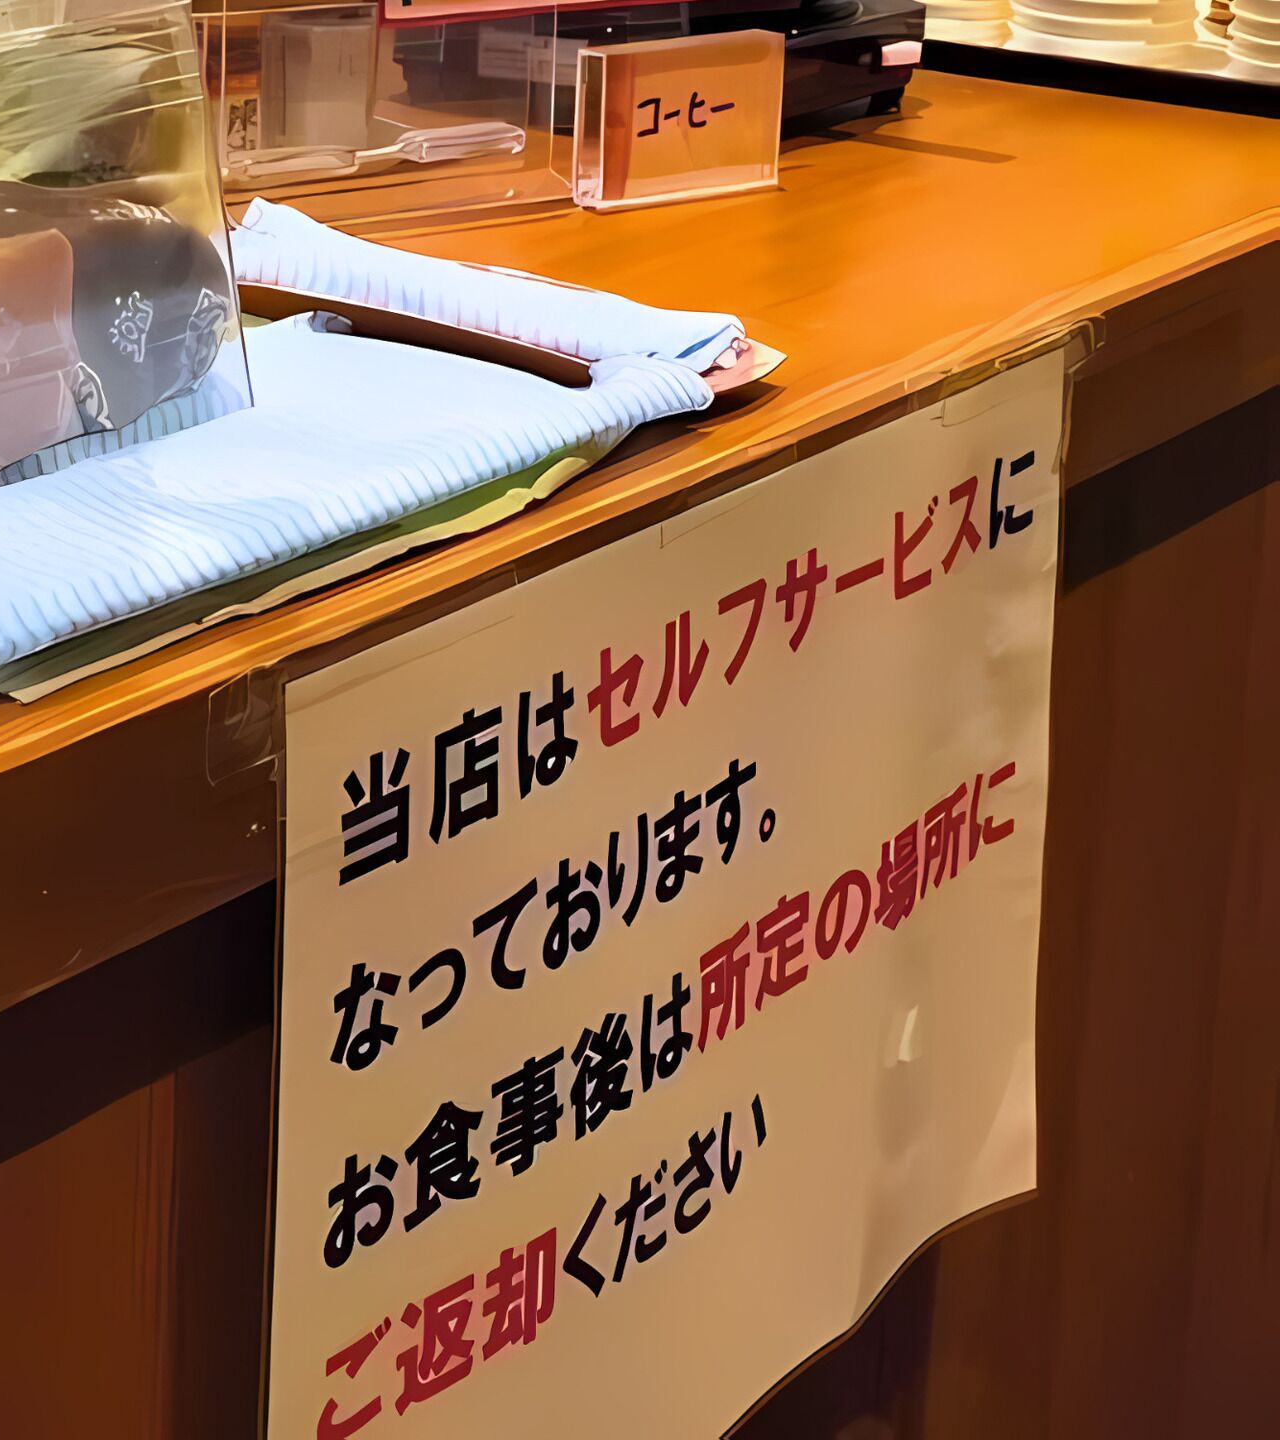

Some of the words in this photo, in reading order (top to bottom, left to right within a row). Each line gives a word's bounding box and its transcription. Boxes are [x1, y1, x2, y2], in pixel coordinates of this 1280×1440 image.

[637, 92, 735, 137] コーヒー
[338, 450, 1036, 886] 当店はセルフサービスに
[322, 761, 1016, 1268] お食事後は所定の場所に
[329, 758, 776, 1072] なっております。
